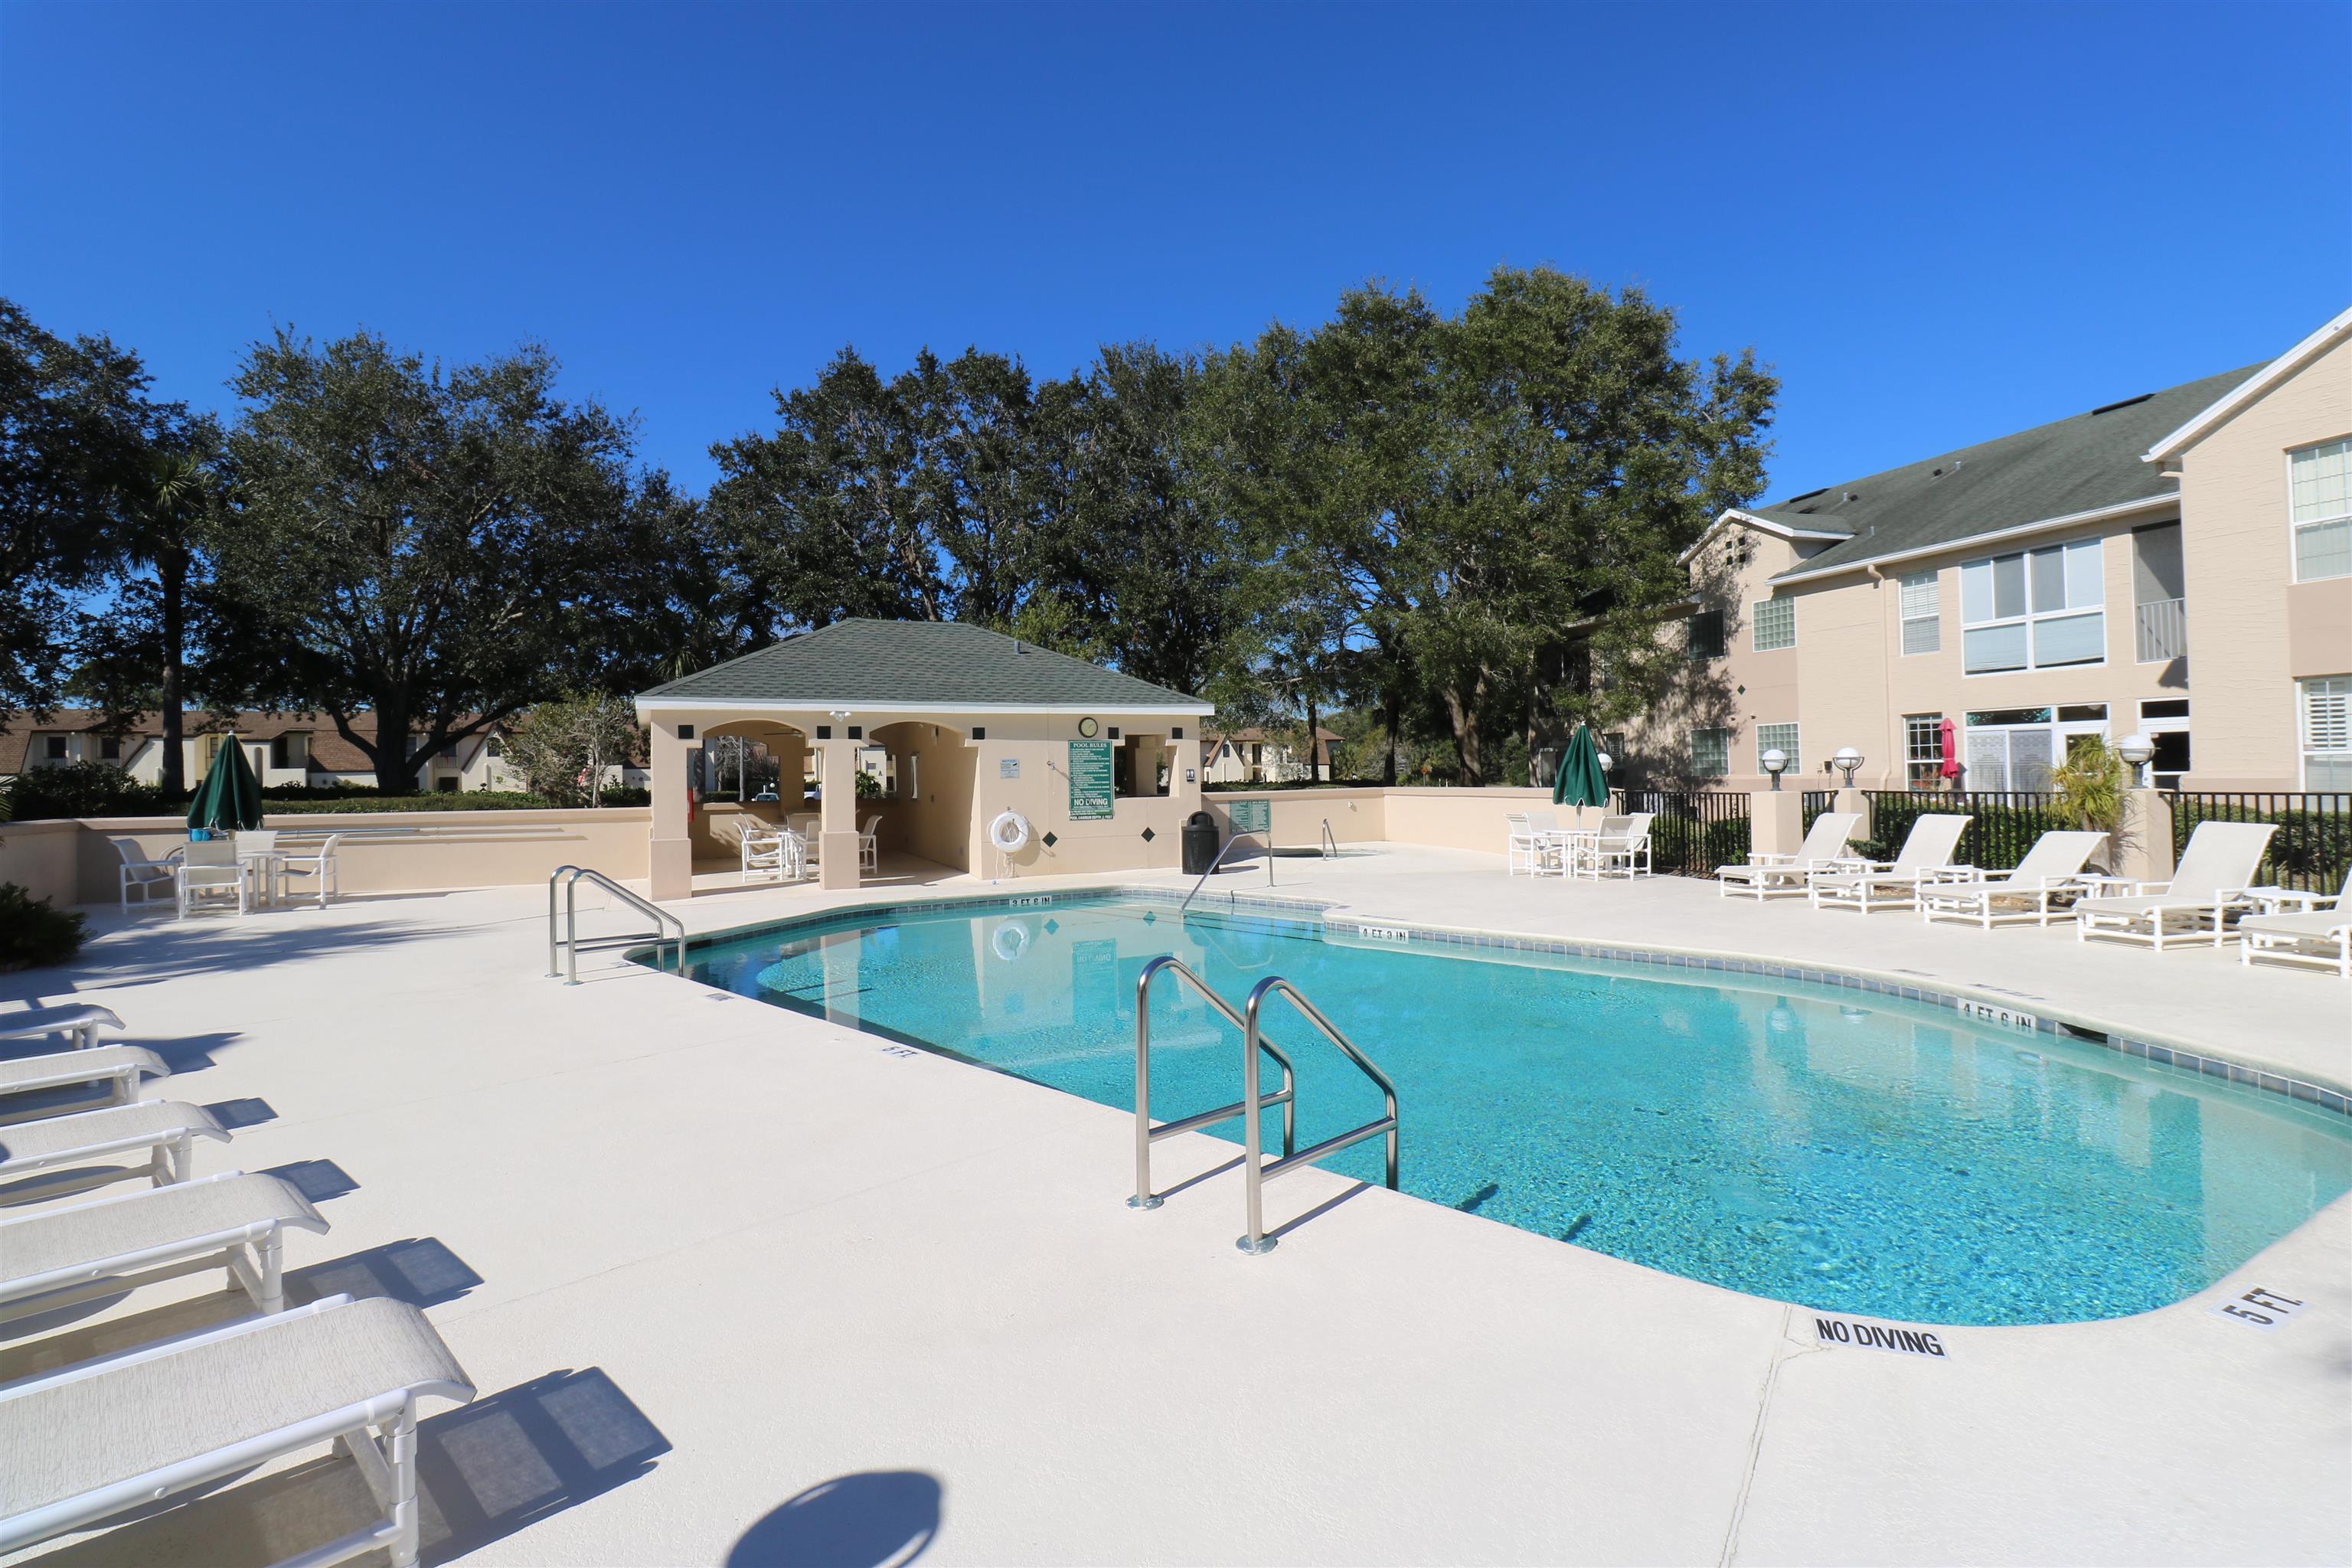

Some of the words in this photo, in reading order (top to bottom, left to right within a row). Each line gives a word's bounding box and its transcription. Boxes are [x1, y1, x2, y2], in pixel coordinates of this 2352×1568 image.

[1073, 798, 1084, 806] NO
[1085, 798, 1108, 806] DIVING
[1396, 931, 1406, 940] IN
[2016, 1015, 2031, 1028] IN
[2221, 1305, 2274, 1325] 5
[1816, 1318, 1850, 1343] NO
[1853, 1324, 1945, 1356] DIVING
